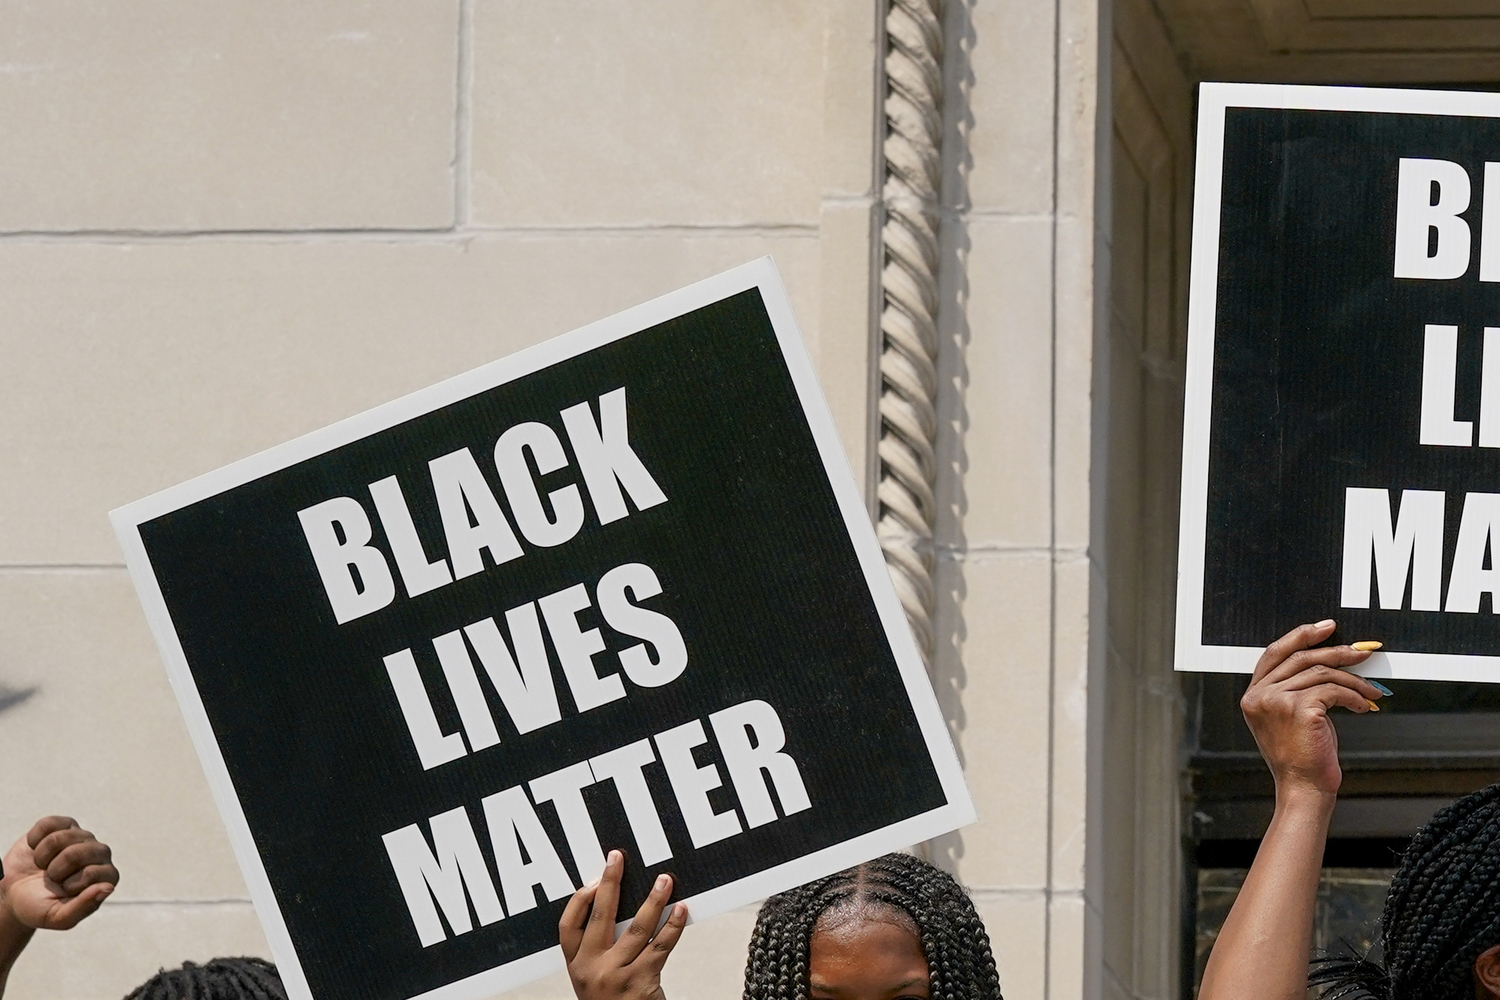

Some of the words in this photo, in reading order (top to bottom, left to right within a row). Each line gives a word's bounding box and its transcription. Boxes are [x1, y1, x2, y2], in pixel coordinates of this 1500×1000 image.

[297, 387, 668, 625] BLACK
[383, 563, 688, 771] LIVES
[382, 700, 812, 948] MATTER
